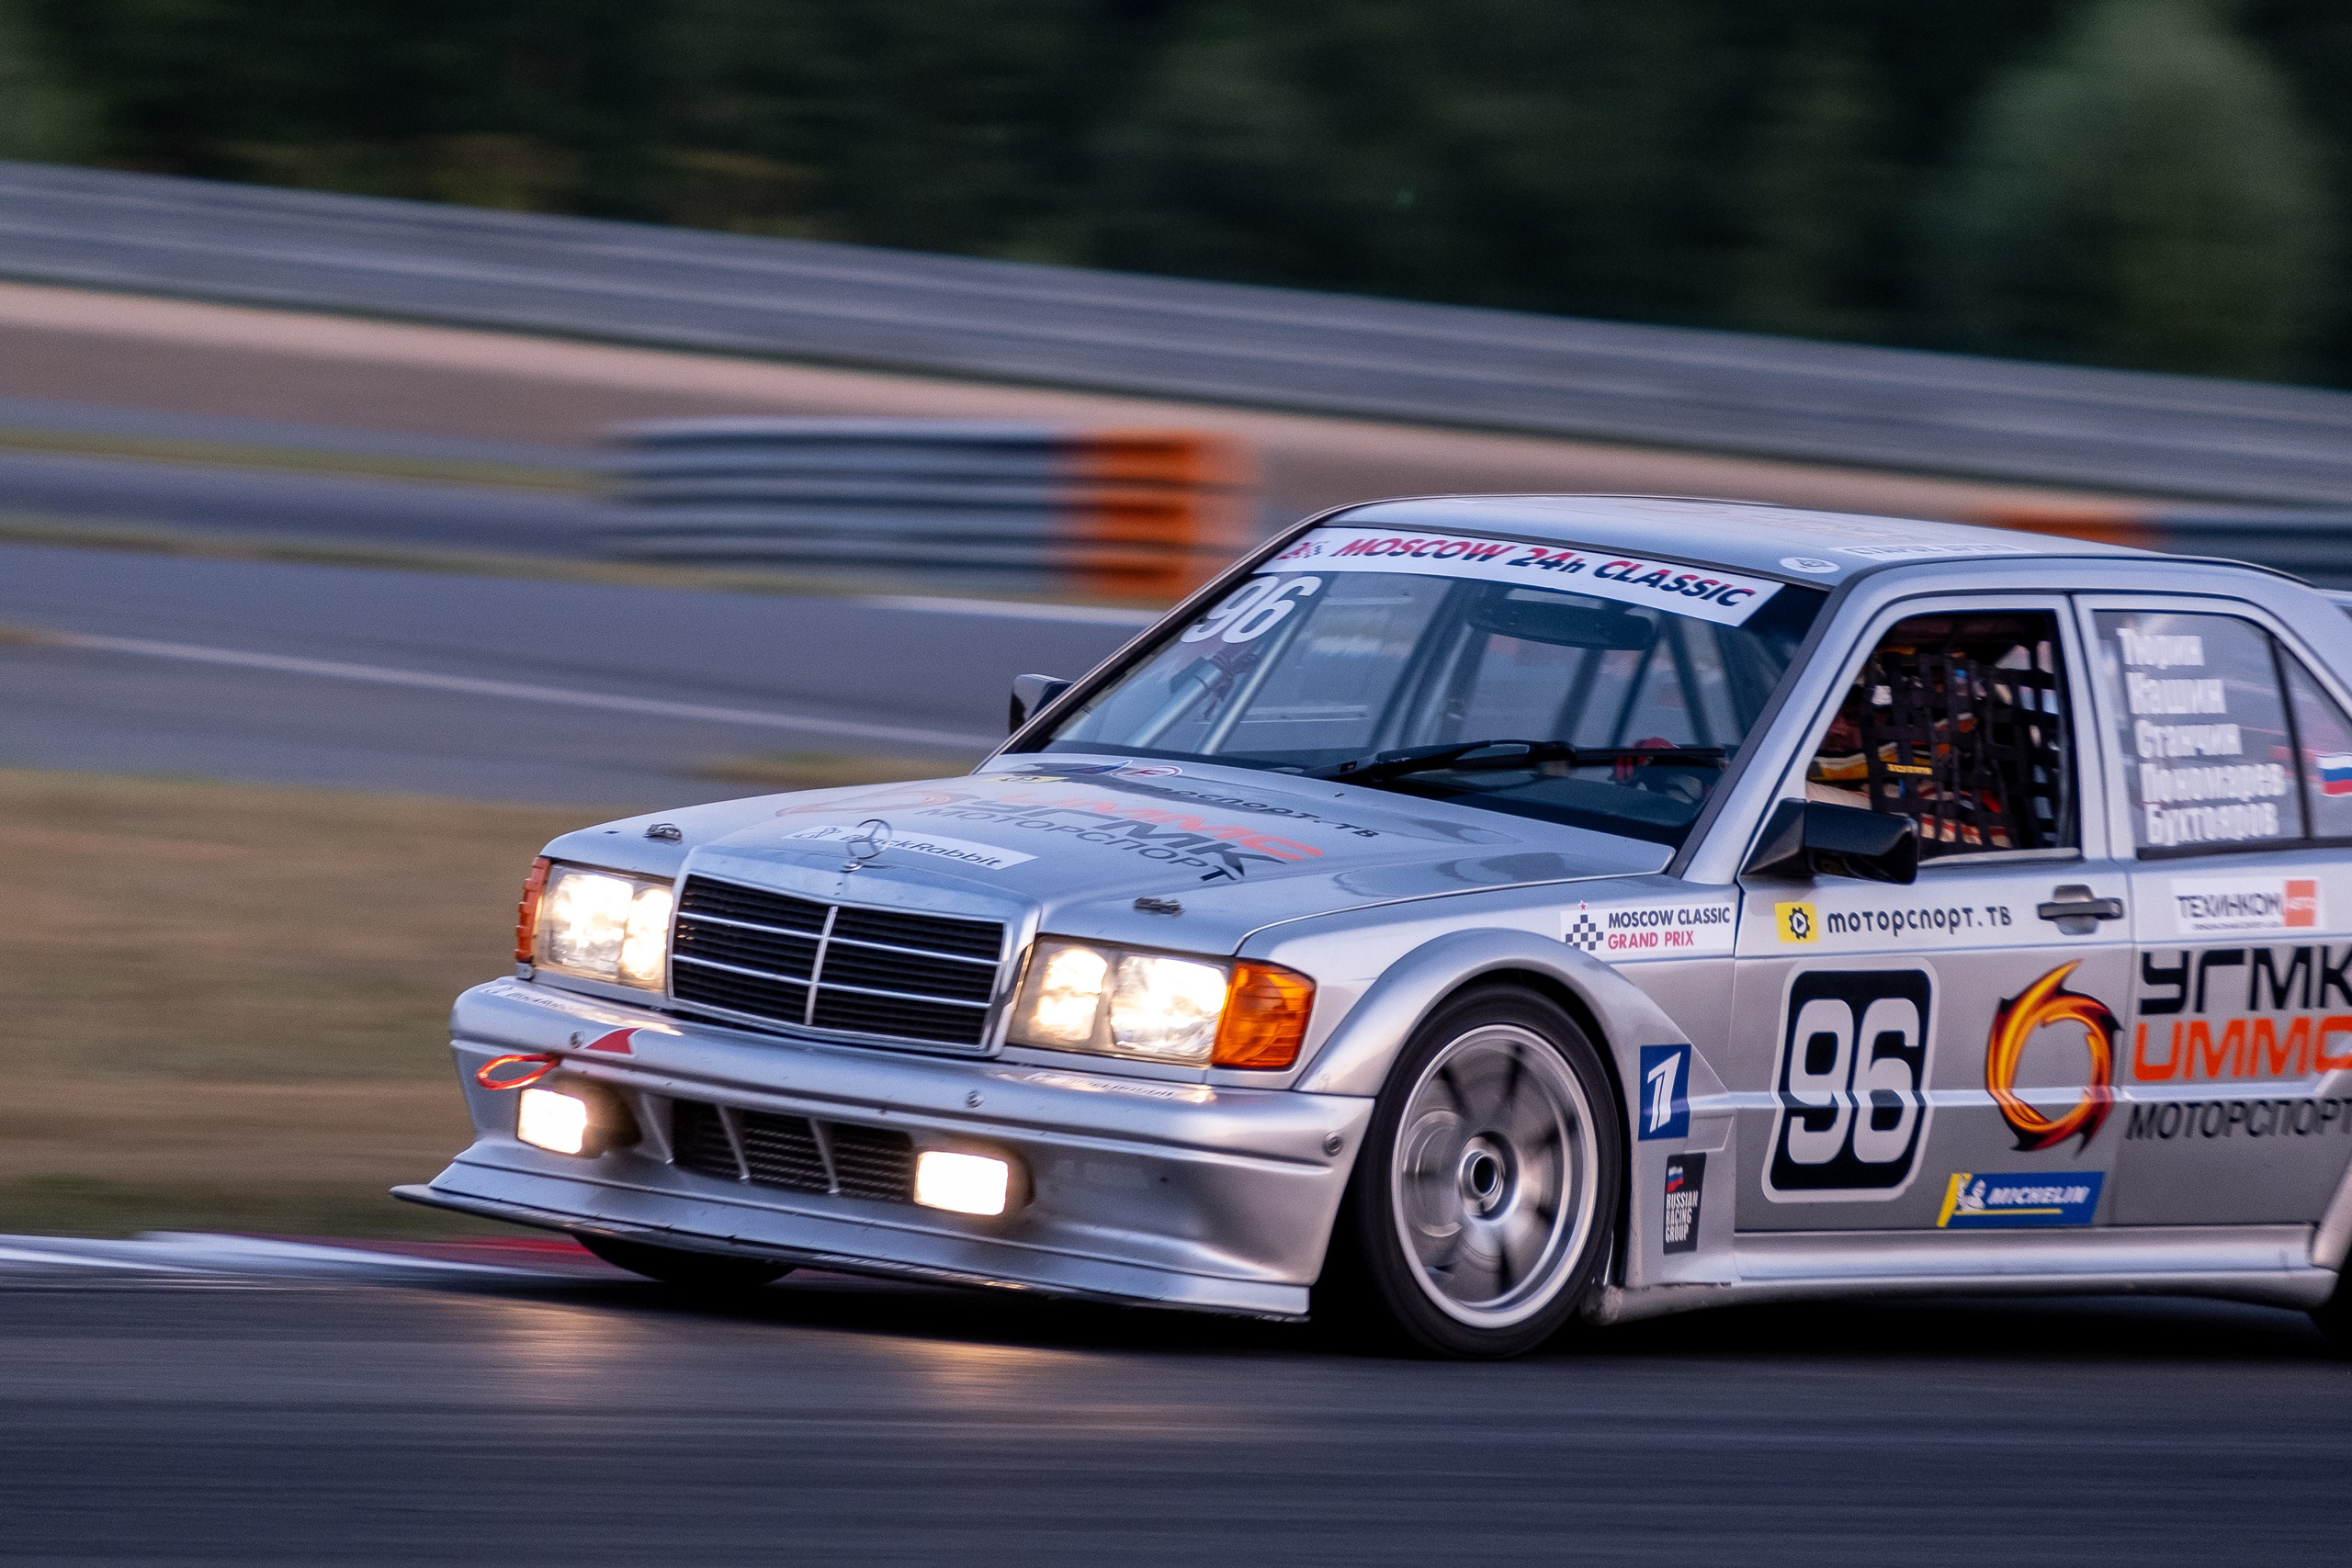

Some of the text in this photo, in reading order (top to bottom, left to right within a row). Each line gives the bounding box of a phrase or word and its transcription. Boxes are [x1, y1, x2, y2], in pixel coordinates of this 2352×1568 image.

[1329, 538, 1756, 607] MOSCOW 24h CLASSIC
[1181, 576, 1322, 643] 96
[840, 833, 1002, 866] BackRabbit
[912, 808, 1238, 882] МОТОРСПОРТ
[1608, 907, 1731, 929] MOSCOW CLASSIC
[1608, 931, 1694, 950] GRAND PRIX
[2140, 944, 2352, 1015] УГМК
[1787, 997, 1921, 1165] 96
[1666, 1190, 1699, 1210] RUSSIAN
[1985, 1185, 2091, 1205] MICHELIN
[1666, 1207, 1692, 1227] RACING
[1665, 1224, 1690, 1243] GROUP
